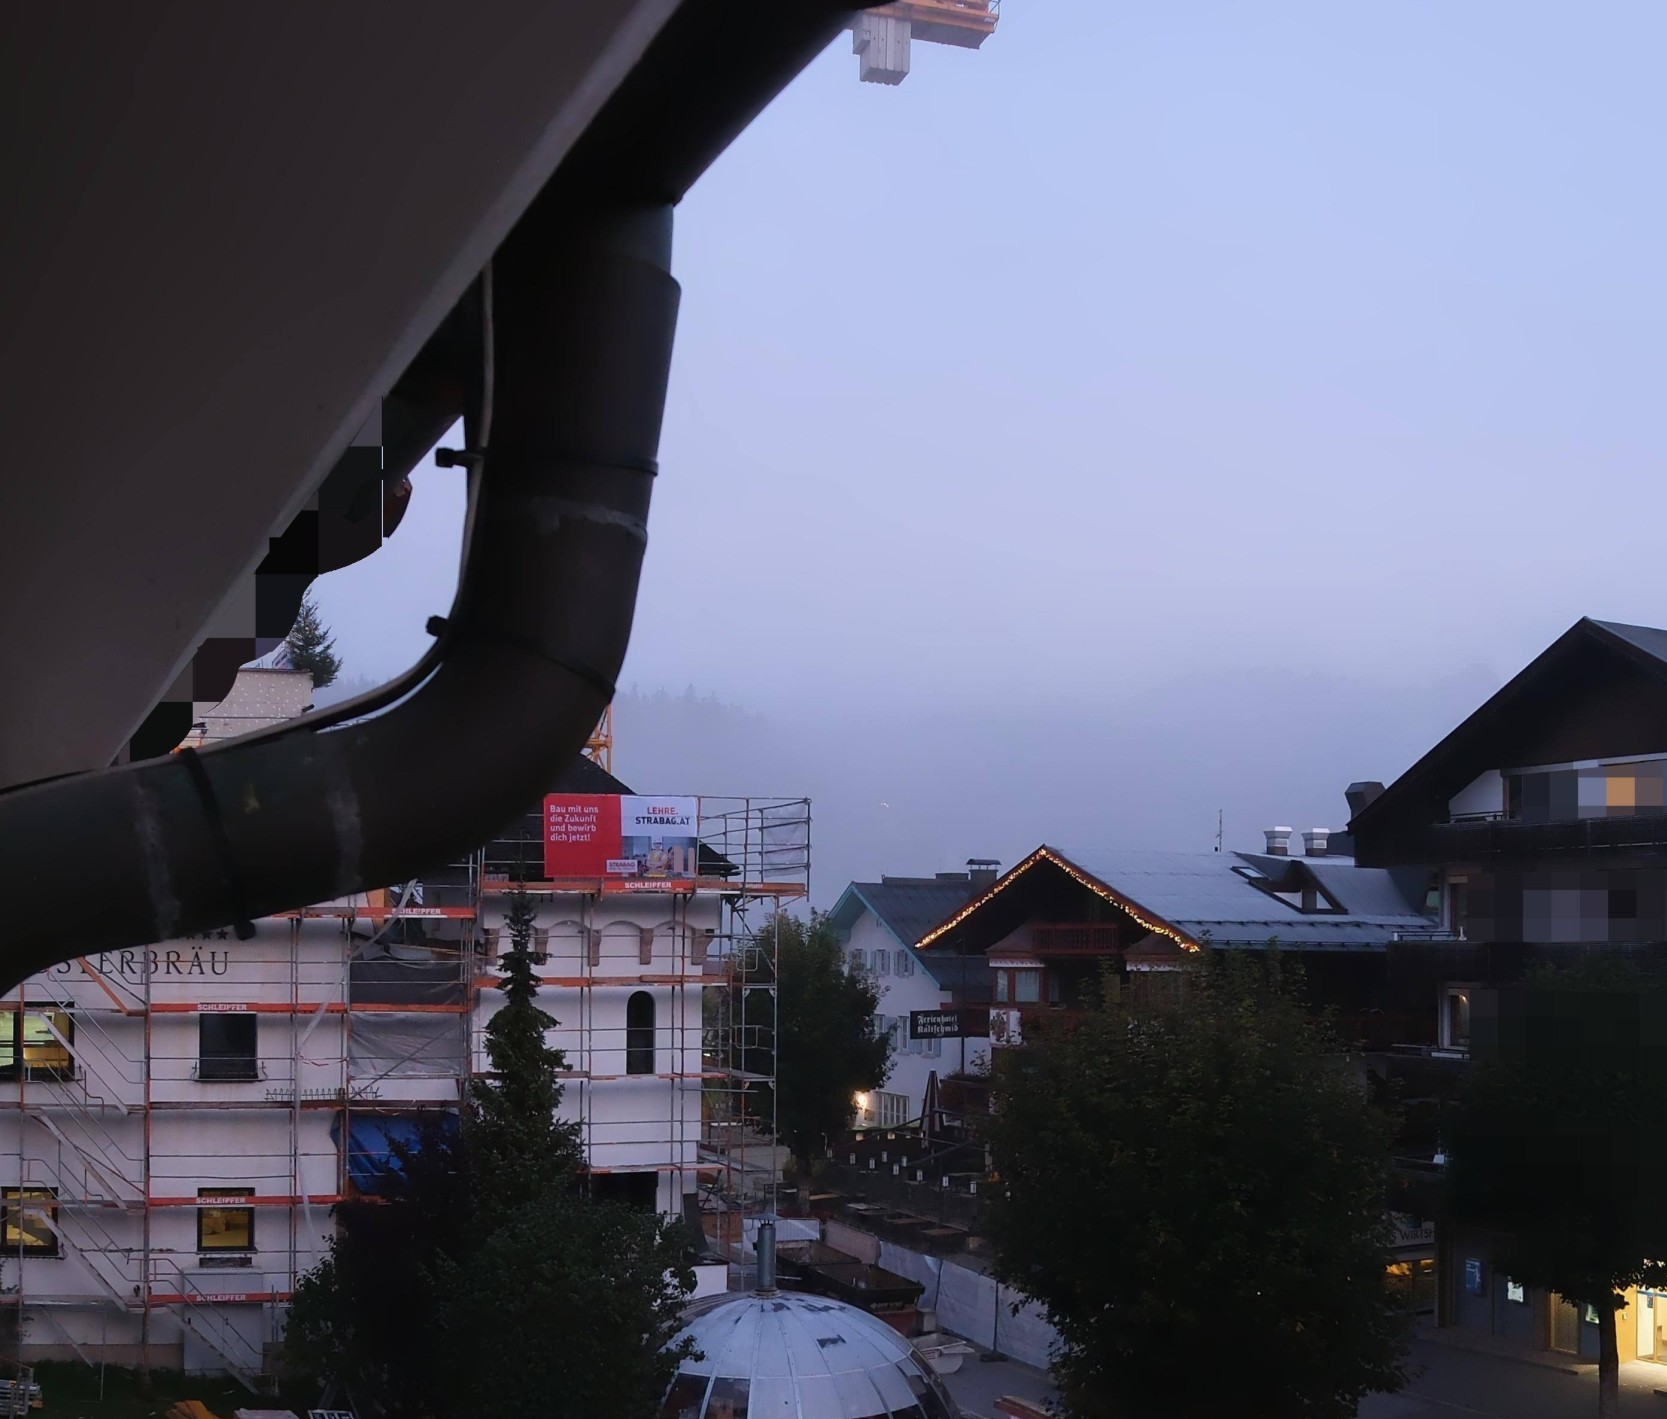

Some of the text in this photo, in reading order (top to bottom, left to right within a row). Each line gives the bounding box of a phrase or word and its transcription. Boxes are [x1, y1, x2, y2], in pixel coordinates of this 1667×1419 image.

[550, 804, 599, 814] Bau mit uns
[647, 806, 679, 815] LEHRE.
[550, 814, 597, 823] die Zukunft
[635, 816, 691, 826] STRABAG.AT
[550, 824, 597, 832] und bewirb
[550, 833, 591, 843] dich jetzt!
[624, 881, 672, 889] SCHLEIPFER
[391, 907, 442, 915] SHLEIPFER
[36, 946, 230, 976] STERBRÄU
[197, 1003, 248, 1012] SCHLEIPFER
[196, 1196, 247, 1204] SCHLEIPFER
